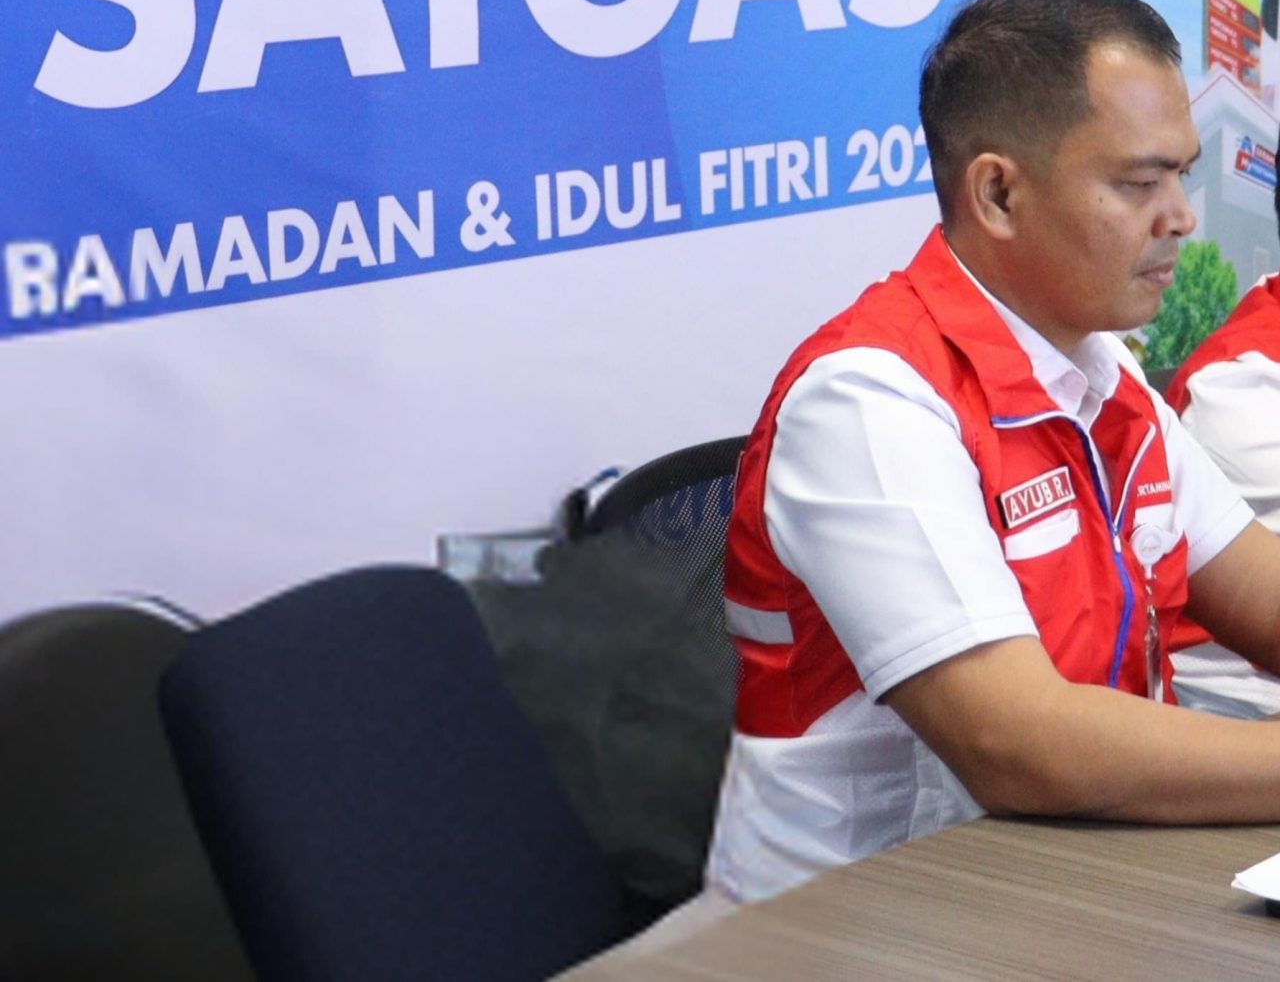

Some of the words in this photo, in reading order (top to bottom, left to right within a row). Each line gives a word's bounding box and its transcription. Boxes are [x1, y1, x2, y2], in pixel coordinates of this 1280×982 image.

[5, 191, 435, 319] RAMADAN
[460, 180, 516, 252] &
[535, 158, 682, 241] IDUL
[700, 136, 829, 216] FITRI
[1008, 481, 1054, 522] AYUB
